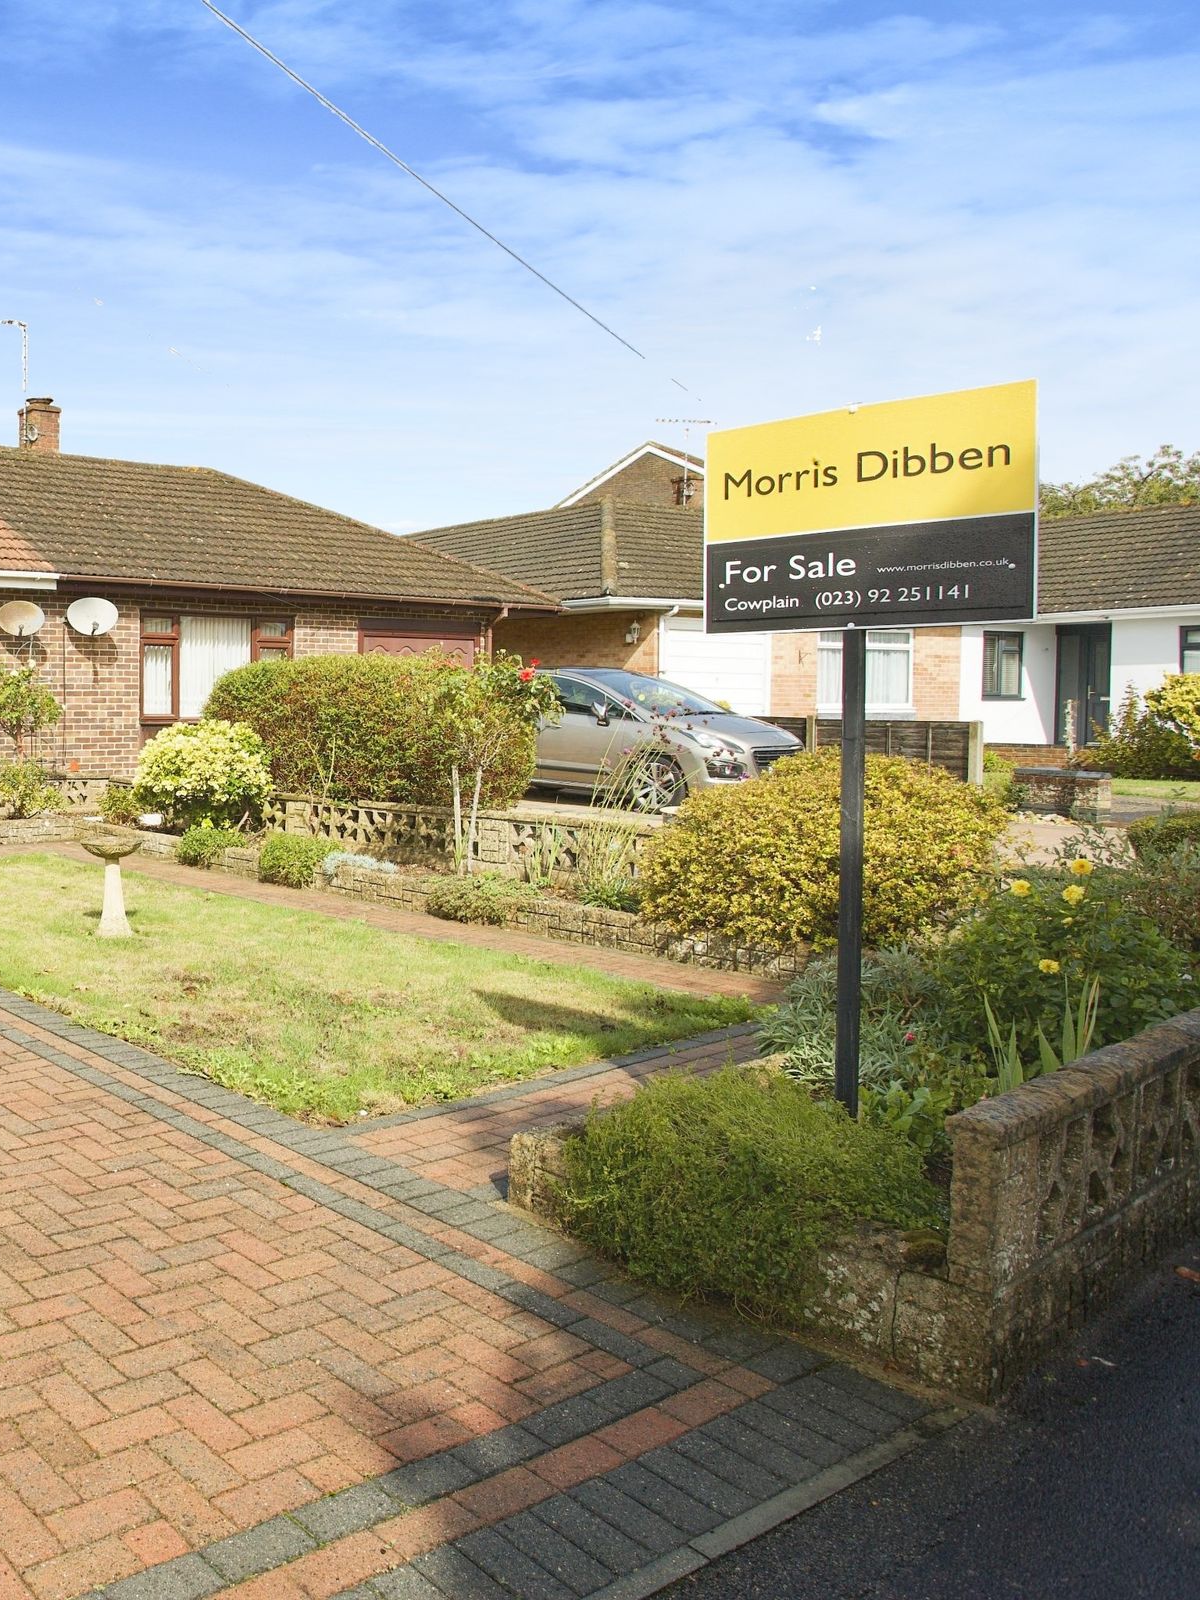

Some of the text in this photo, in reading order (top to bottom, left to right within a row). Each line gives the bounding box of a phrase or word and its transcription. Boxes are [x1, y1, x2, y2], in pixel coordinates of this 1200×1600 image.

[724, 443, 1011, 500] Morris Dibben
[725, 552, 856, 584] For Sale
[877, 558, 1009, 573] www.morrisdibben.co.uk
[724, 585, 970, 613] Cowplain (023) 92 251141
